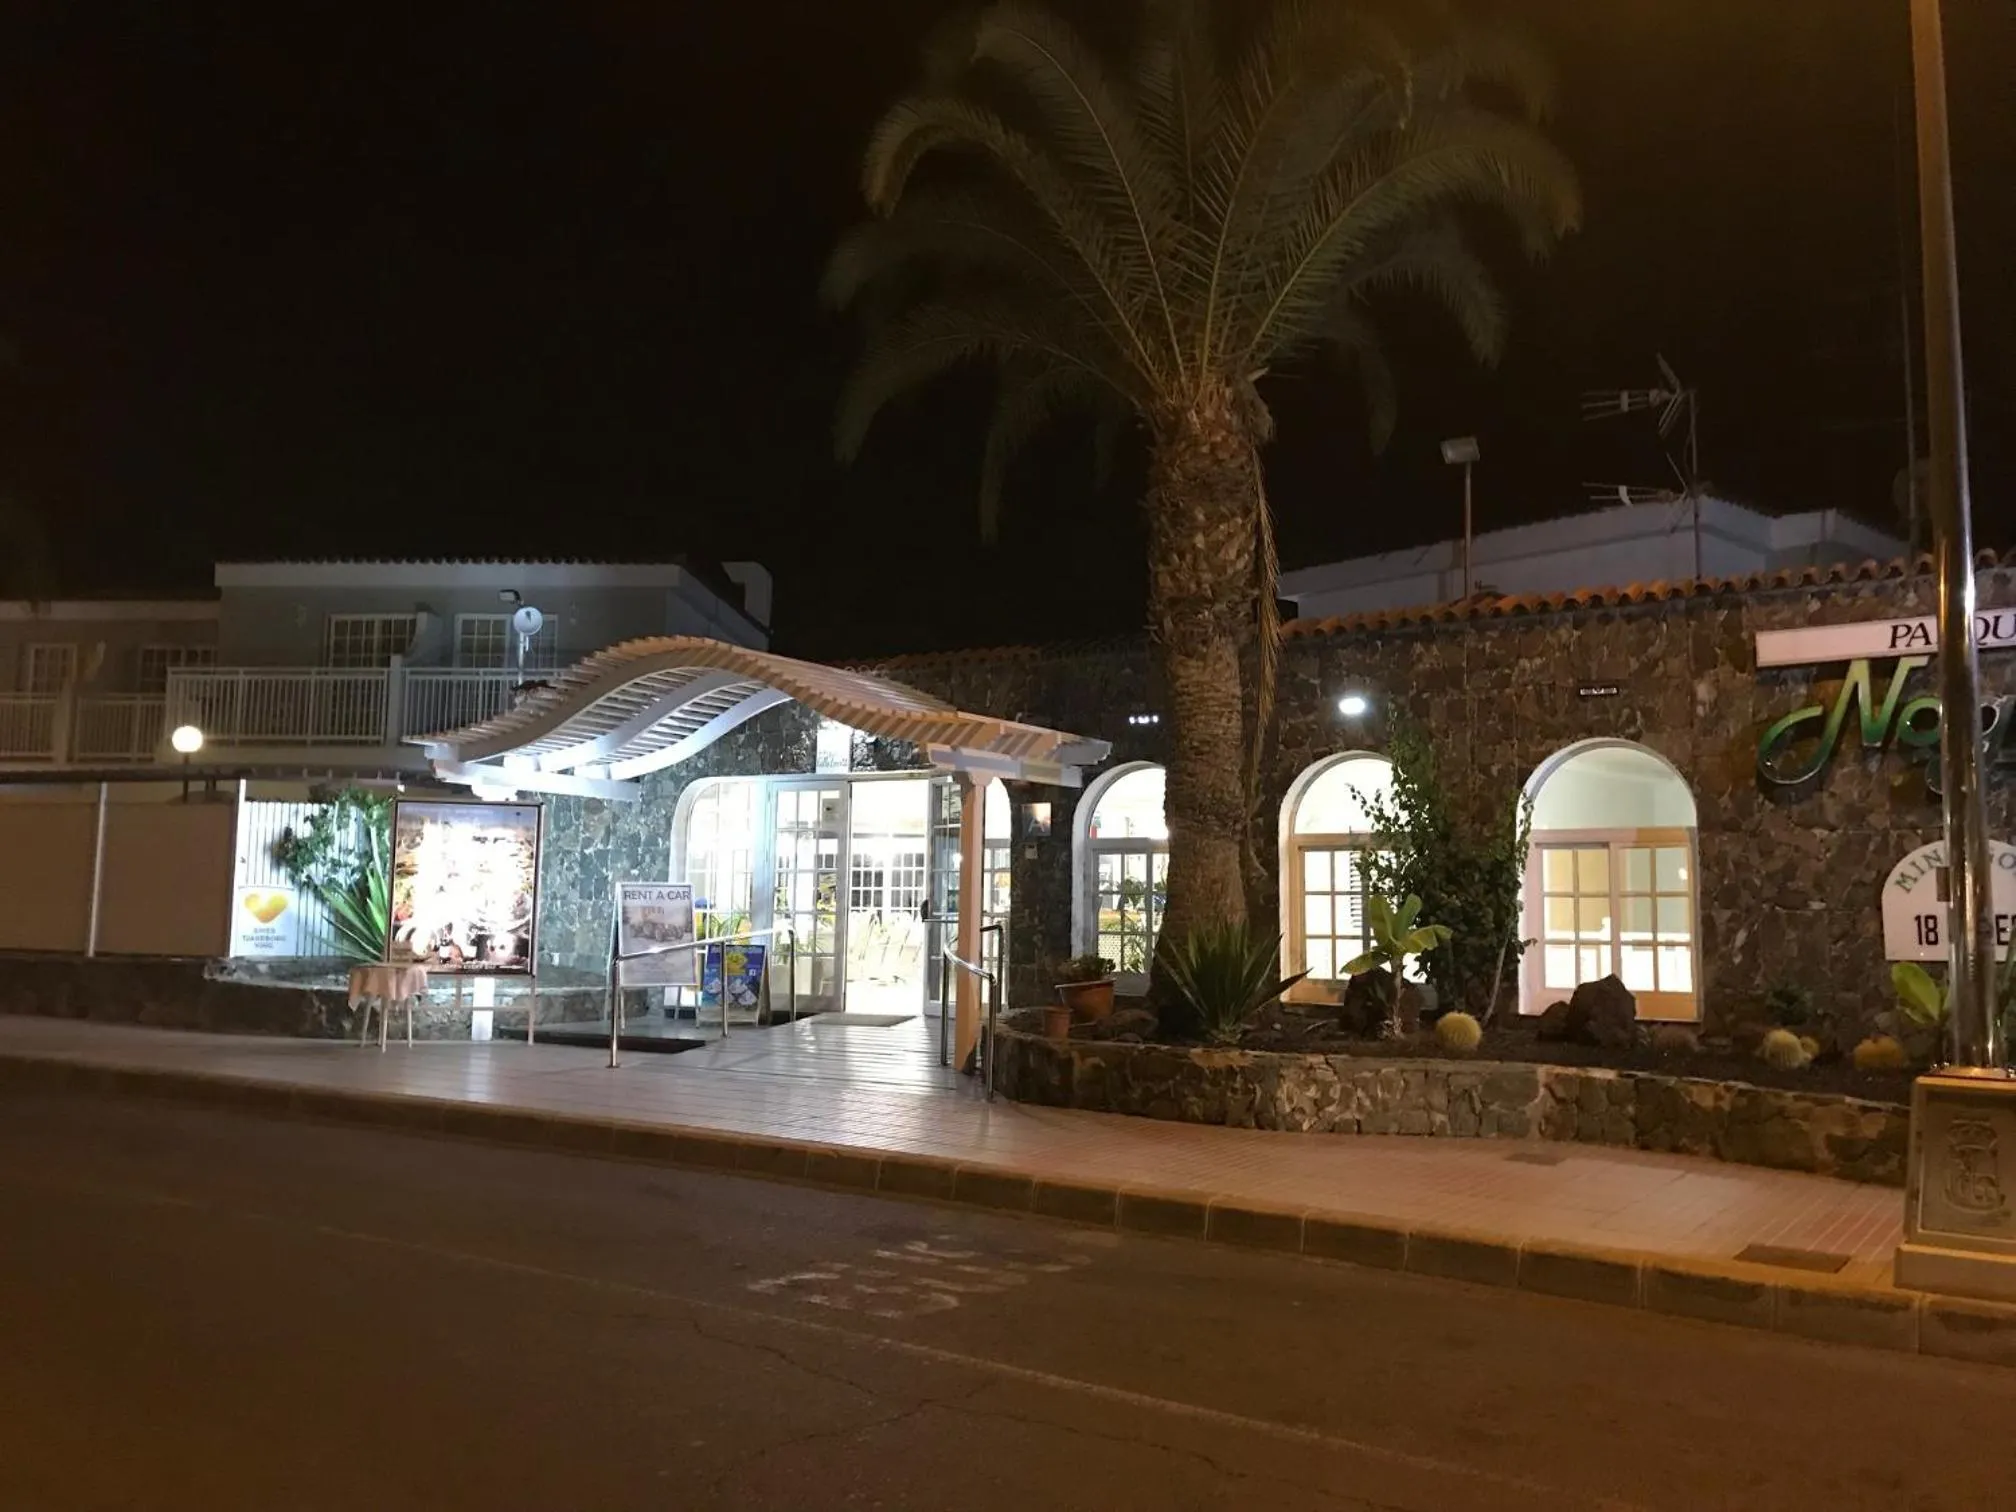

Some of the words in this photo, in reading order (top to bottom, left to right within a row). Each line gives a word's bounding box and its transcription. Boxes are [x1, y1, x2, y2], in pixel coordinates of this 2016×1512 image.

[623, 890, 652, 901] RENT
[656, 890, 666, 901] A
[667, 890, 691, 901] CAR
[1914, 914, 1939, 946] 18
